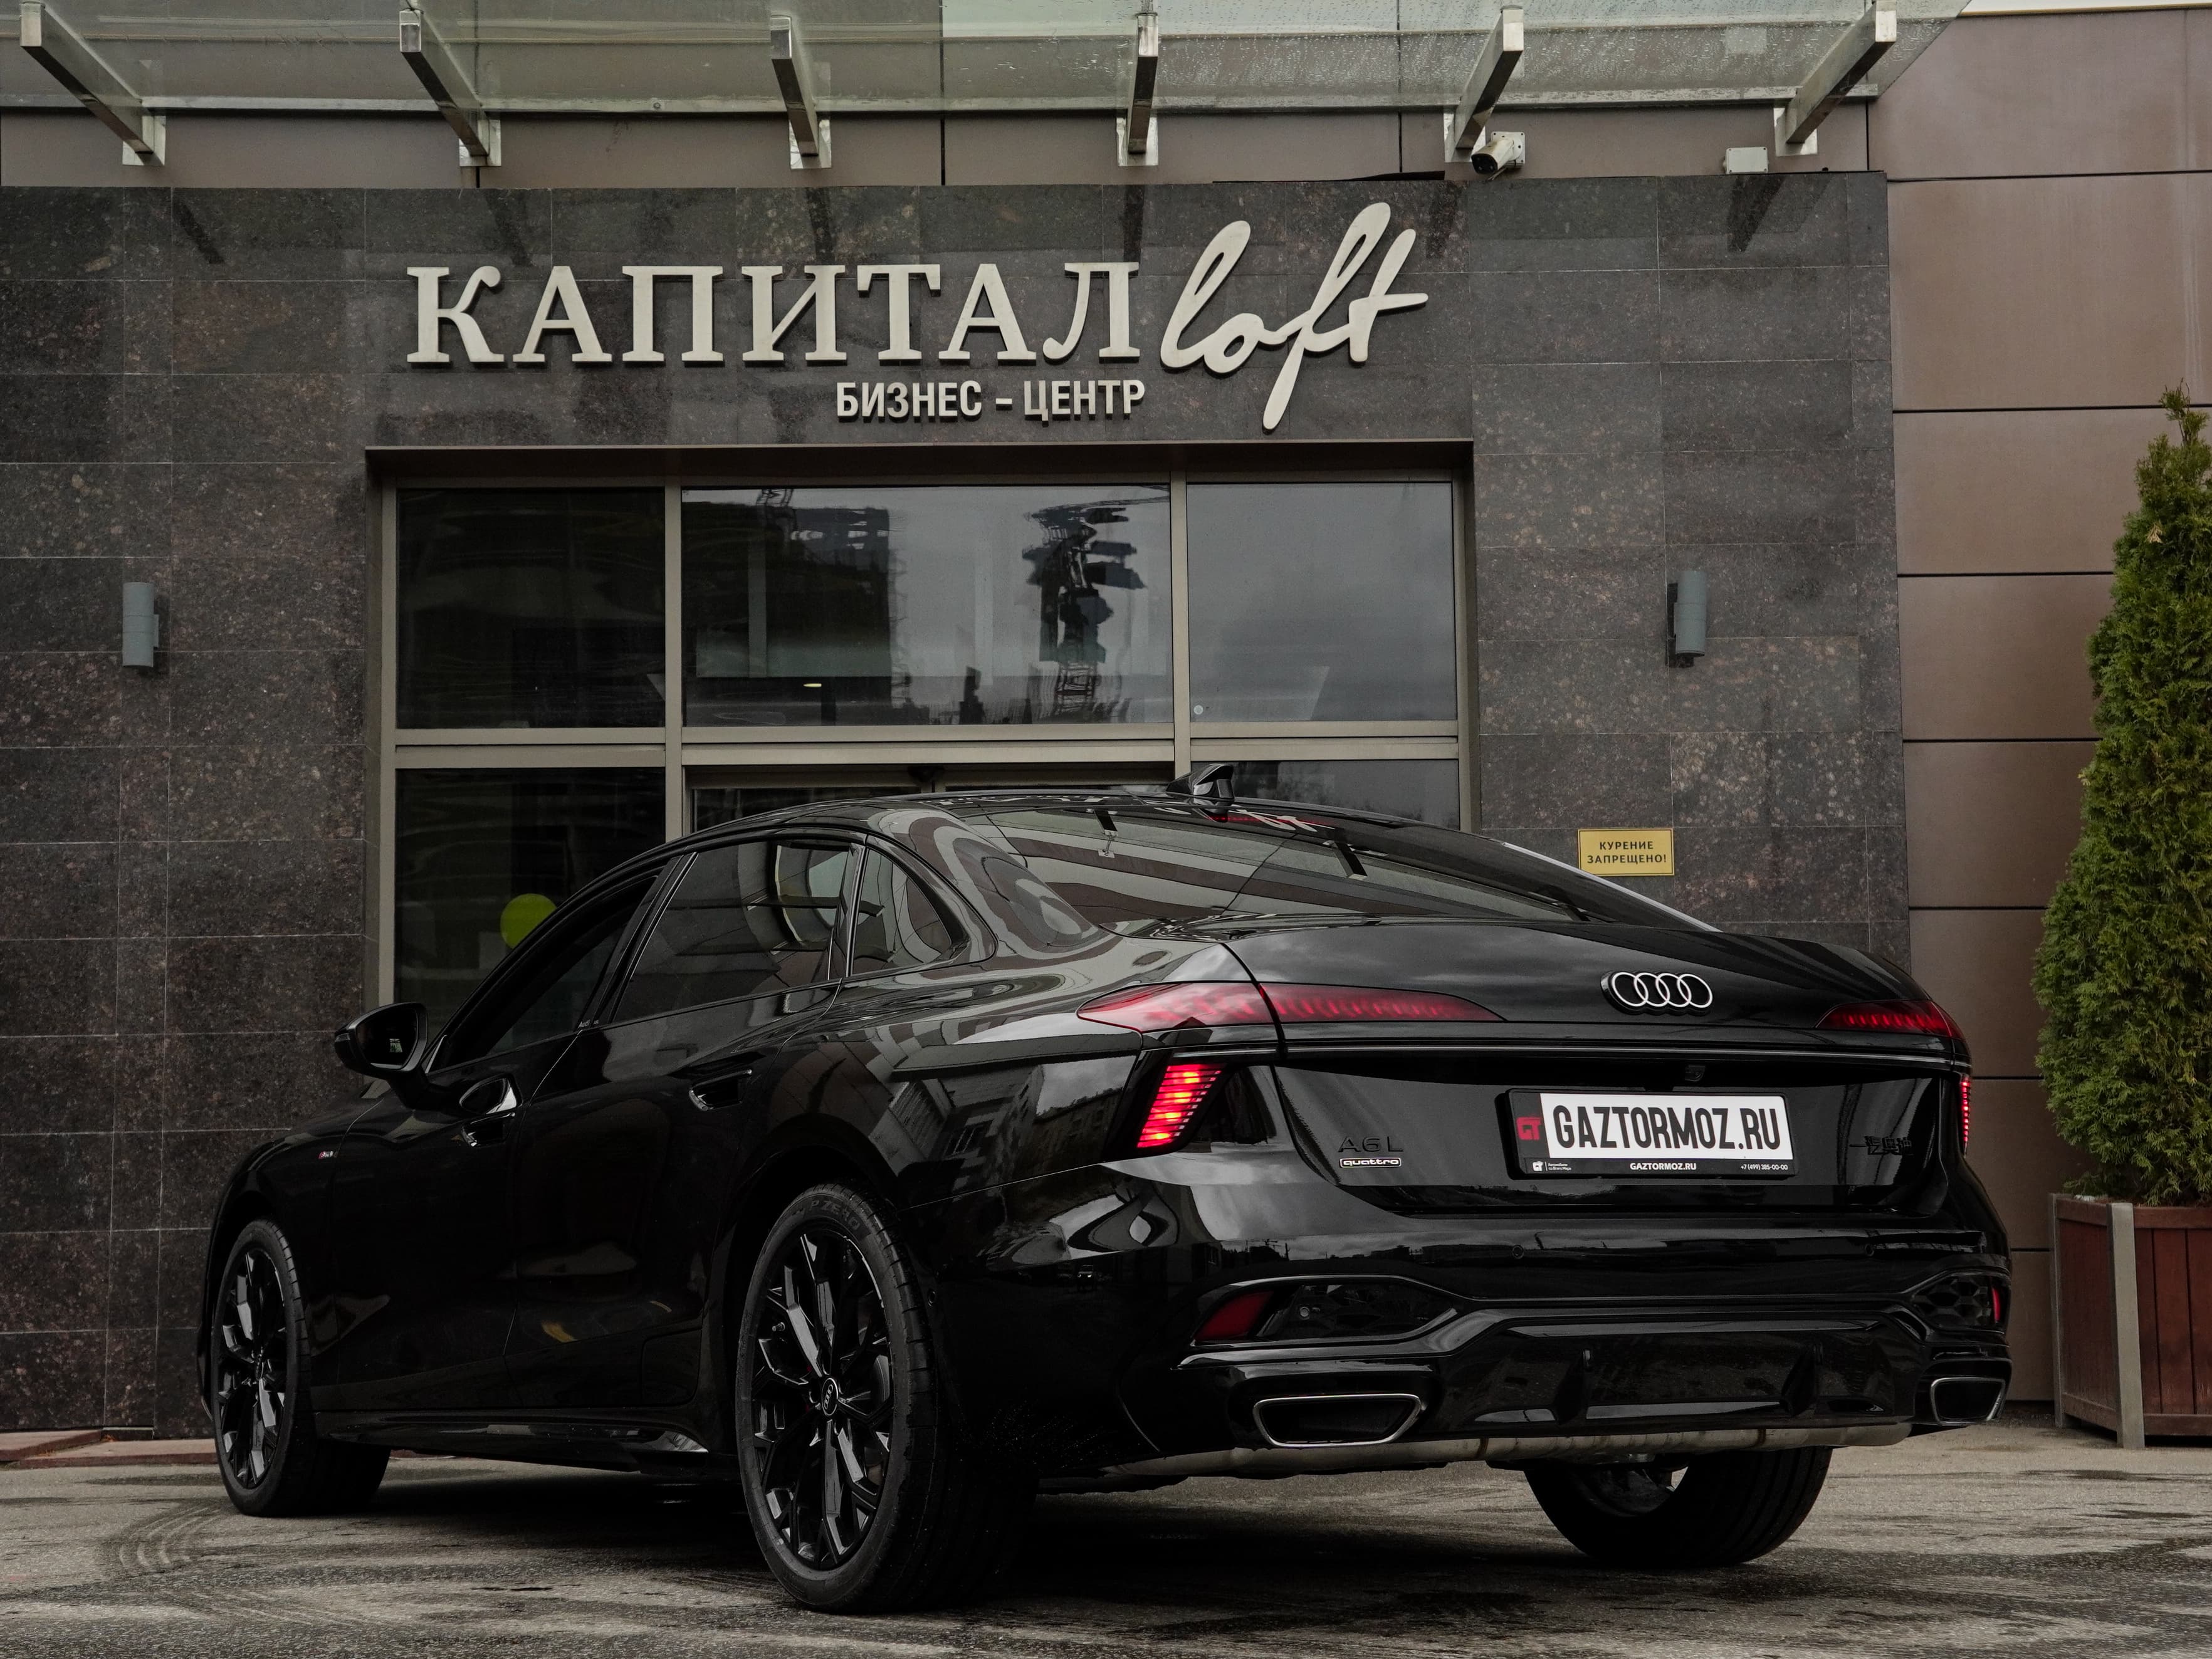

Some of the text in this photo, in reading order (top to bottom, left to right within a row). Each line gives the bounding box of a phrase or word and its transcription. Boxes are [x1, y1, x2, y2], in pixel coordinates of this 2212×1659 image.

[407, 202, 1428, 429] КАПИТАЛ loft
[837, 380, 982, 417] БИЗНЕС
[1024, 379, 1145, 421] ЦЕНТР
[1587, 854, 1667, 864] ЗАПРЕЩЕНО!
[1600, 841, 1654, 850] КУРЕНИЕ
[1553, 1105, 1781, 1150] GAZTORMOZ.RU
